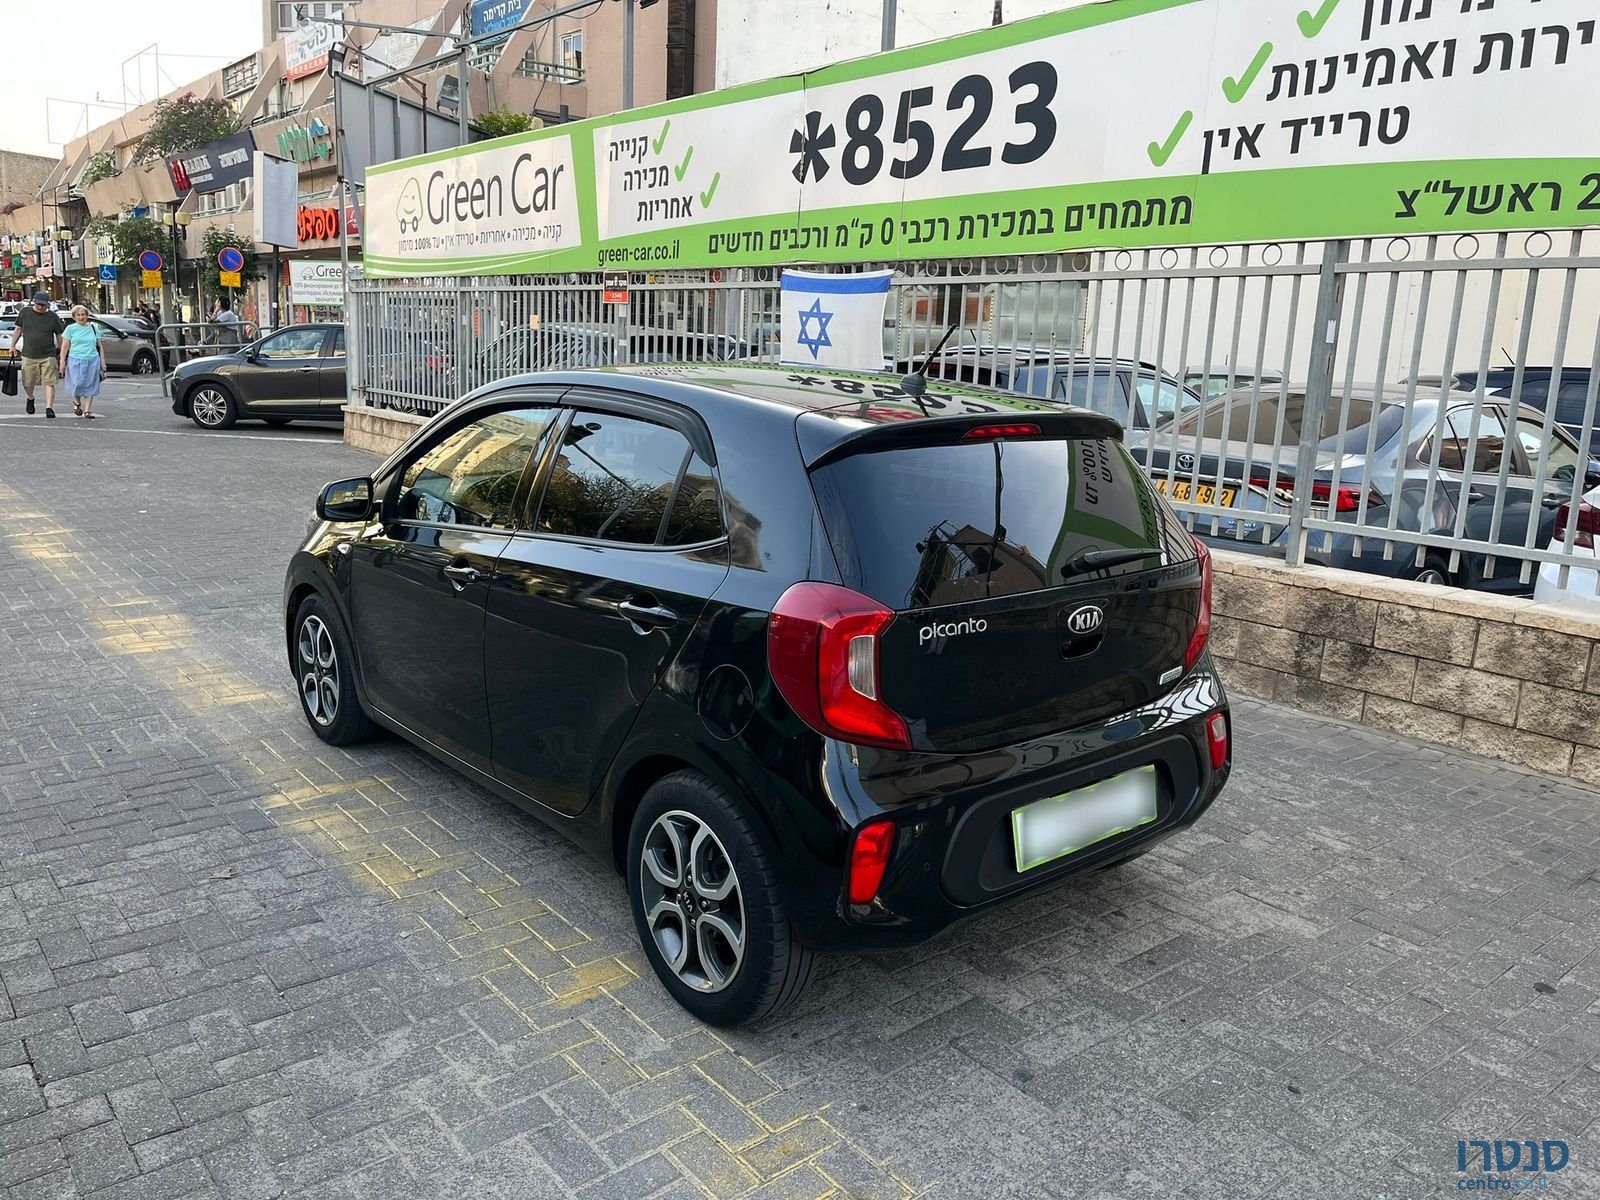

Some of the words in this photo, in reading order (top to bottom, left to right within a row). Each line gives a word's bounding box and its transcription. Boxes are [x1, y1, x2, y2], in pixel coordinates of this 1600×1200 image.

[1473, 20, 1596, 75] ירות
[1266, 38, 1457, 102] ואמינות
[1281, 105, 1410, 154] טרייד
[609, 136, 649, 164] קנייה
[1201, 123, 1266, 175] אין
[427, 170, 502, 225] Green
[511, 153, 564, 215] Car
[623, 165, 669, 191] מכירה
[637, 195, 693, 222] אחריות
[956, 204, 1054, 240] במכירת
[1064, 195, 1193, 233] מתמחים
[479, 230, 506, 245] אחריות
[512, 226, 537, 241] מכירה
[542, 224, 562, 243] קניה
[708, 231, 763, 254] חדשים
[769, 225, 828, 250] ורכבים
[899, 216, 950, 245] רכבי
[414, 239, 432, 251] 100%
[598, 239, 680, 267] green-car.co.il
[316, 264, 342, 277] Gree
[919, 617, 988, 646] picanto
